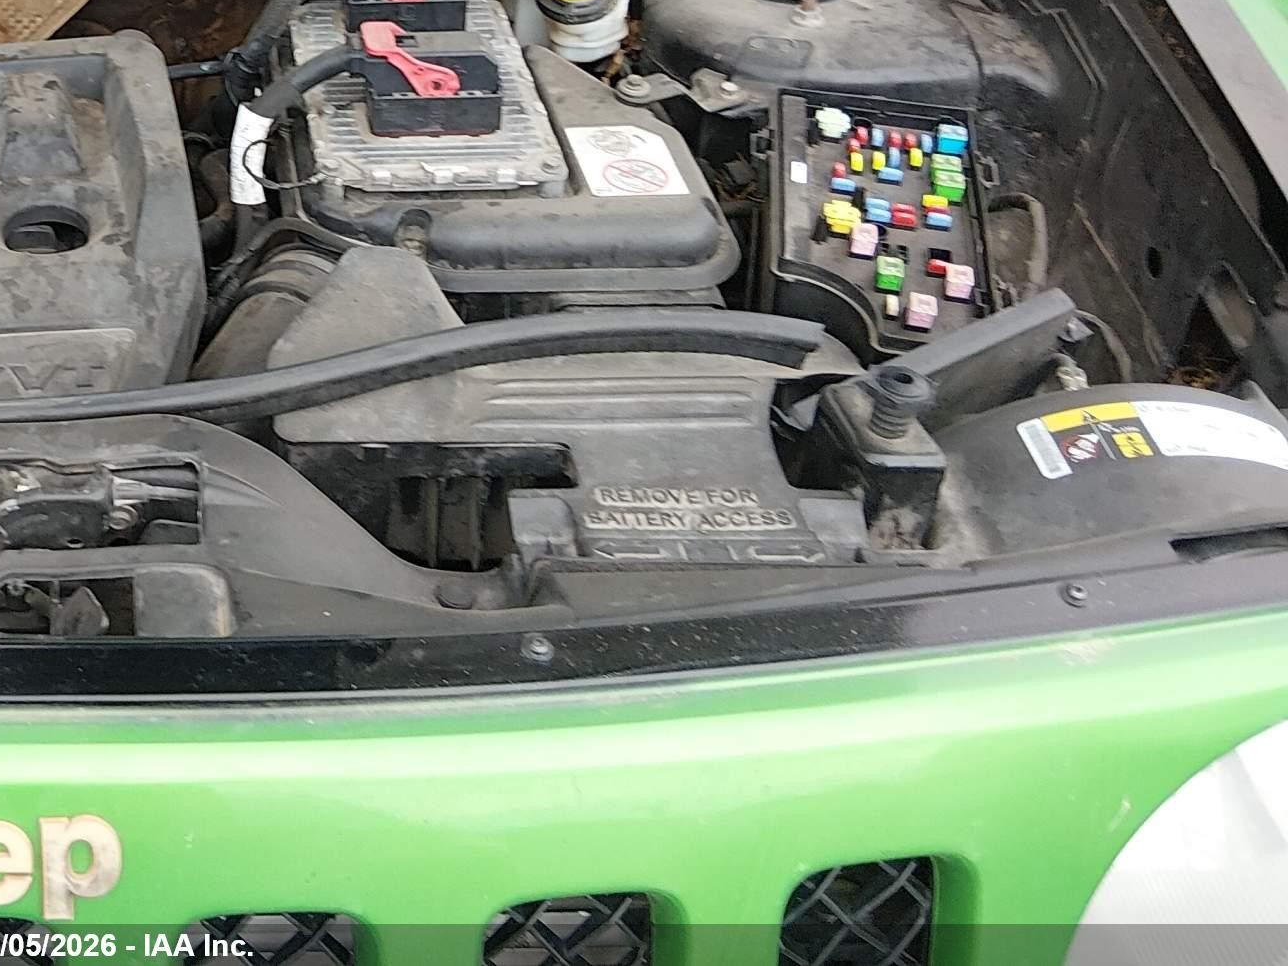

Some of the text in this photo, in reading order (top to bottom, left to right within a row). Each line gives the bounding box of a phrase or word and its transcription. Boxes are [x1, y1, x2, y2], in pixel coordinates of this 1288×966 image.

[599, 487, 760, 506] REMOVE FOR
[586, 509, 796, 528] BATTERY ACCESS
